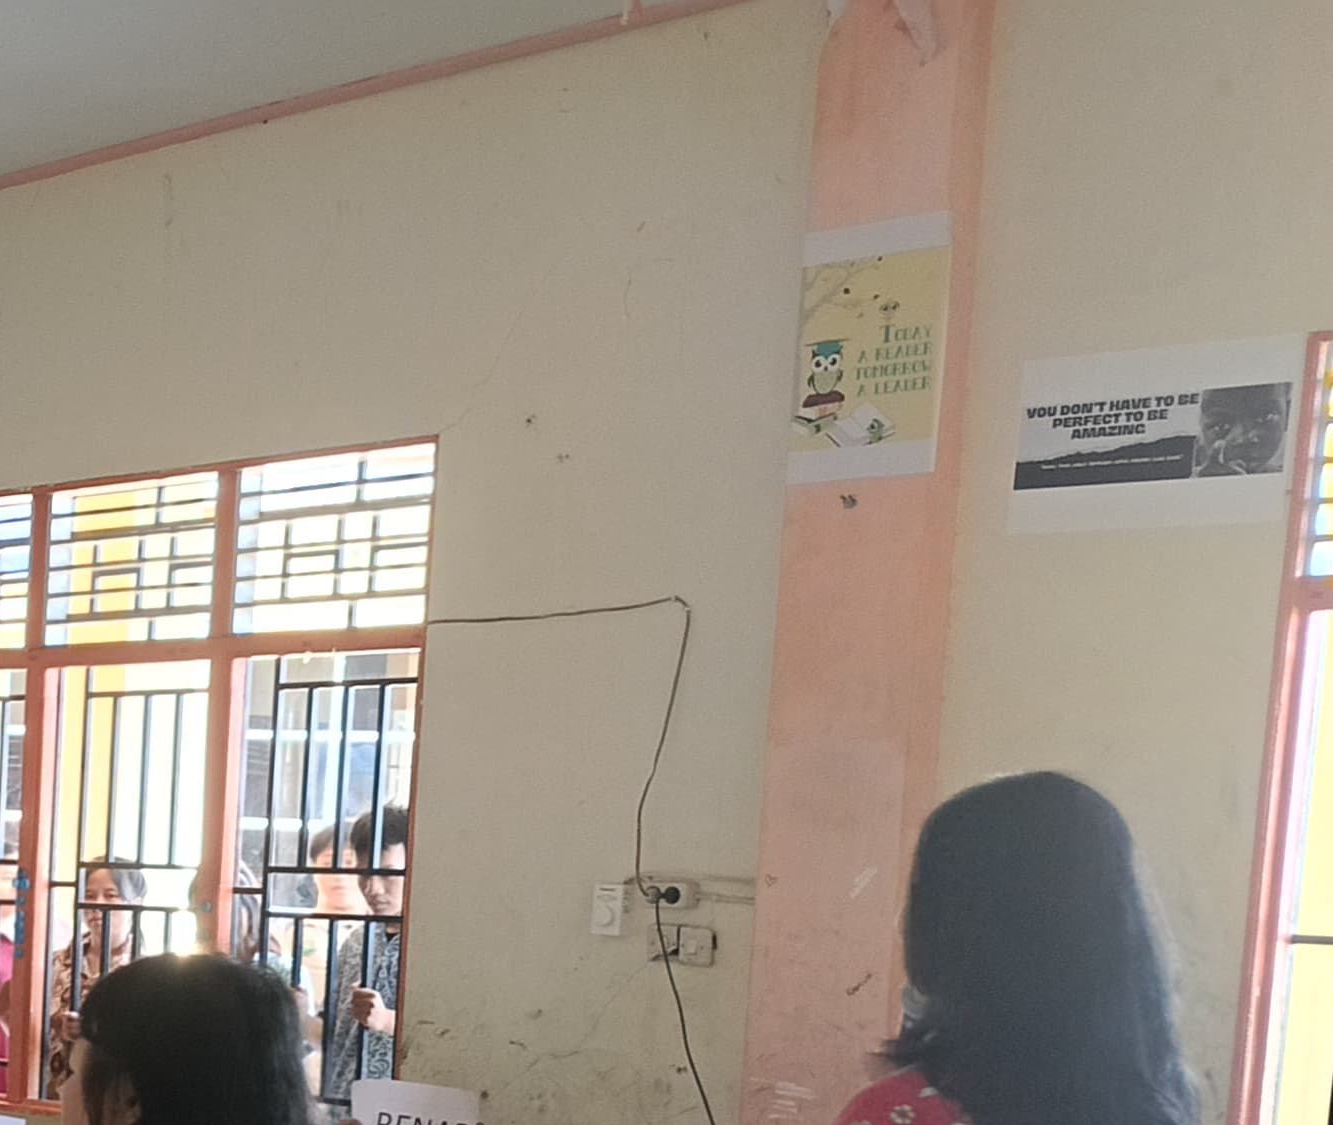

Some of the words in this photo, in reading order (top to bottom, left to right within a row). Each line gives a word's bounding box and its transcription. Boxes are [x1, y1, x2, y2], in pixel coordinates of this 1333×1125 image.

[1026, 406, 1058, 419] YOU
[1060, 402, 1107, 416] DON'T
[1109, 397, 1152, 412] HAVE
[1155, 395, 1175, 407] TO
[1178, 392, 1200, 405] BE
[1052, 412, 1124, 429] PERFECT
[1125, 410, 1144, 423] TO
[1147, 409, 1169, 421] BE
[1071, 424, 1146, 440] AMAZING
